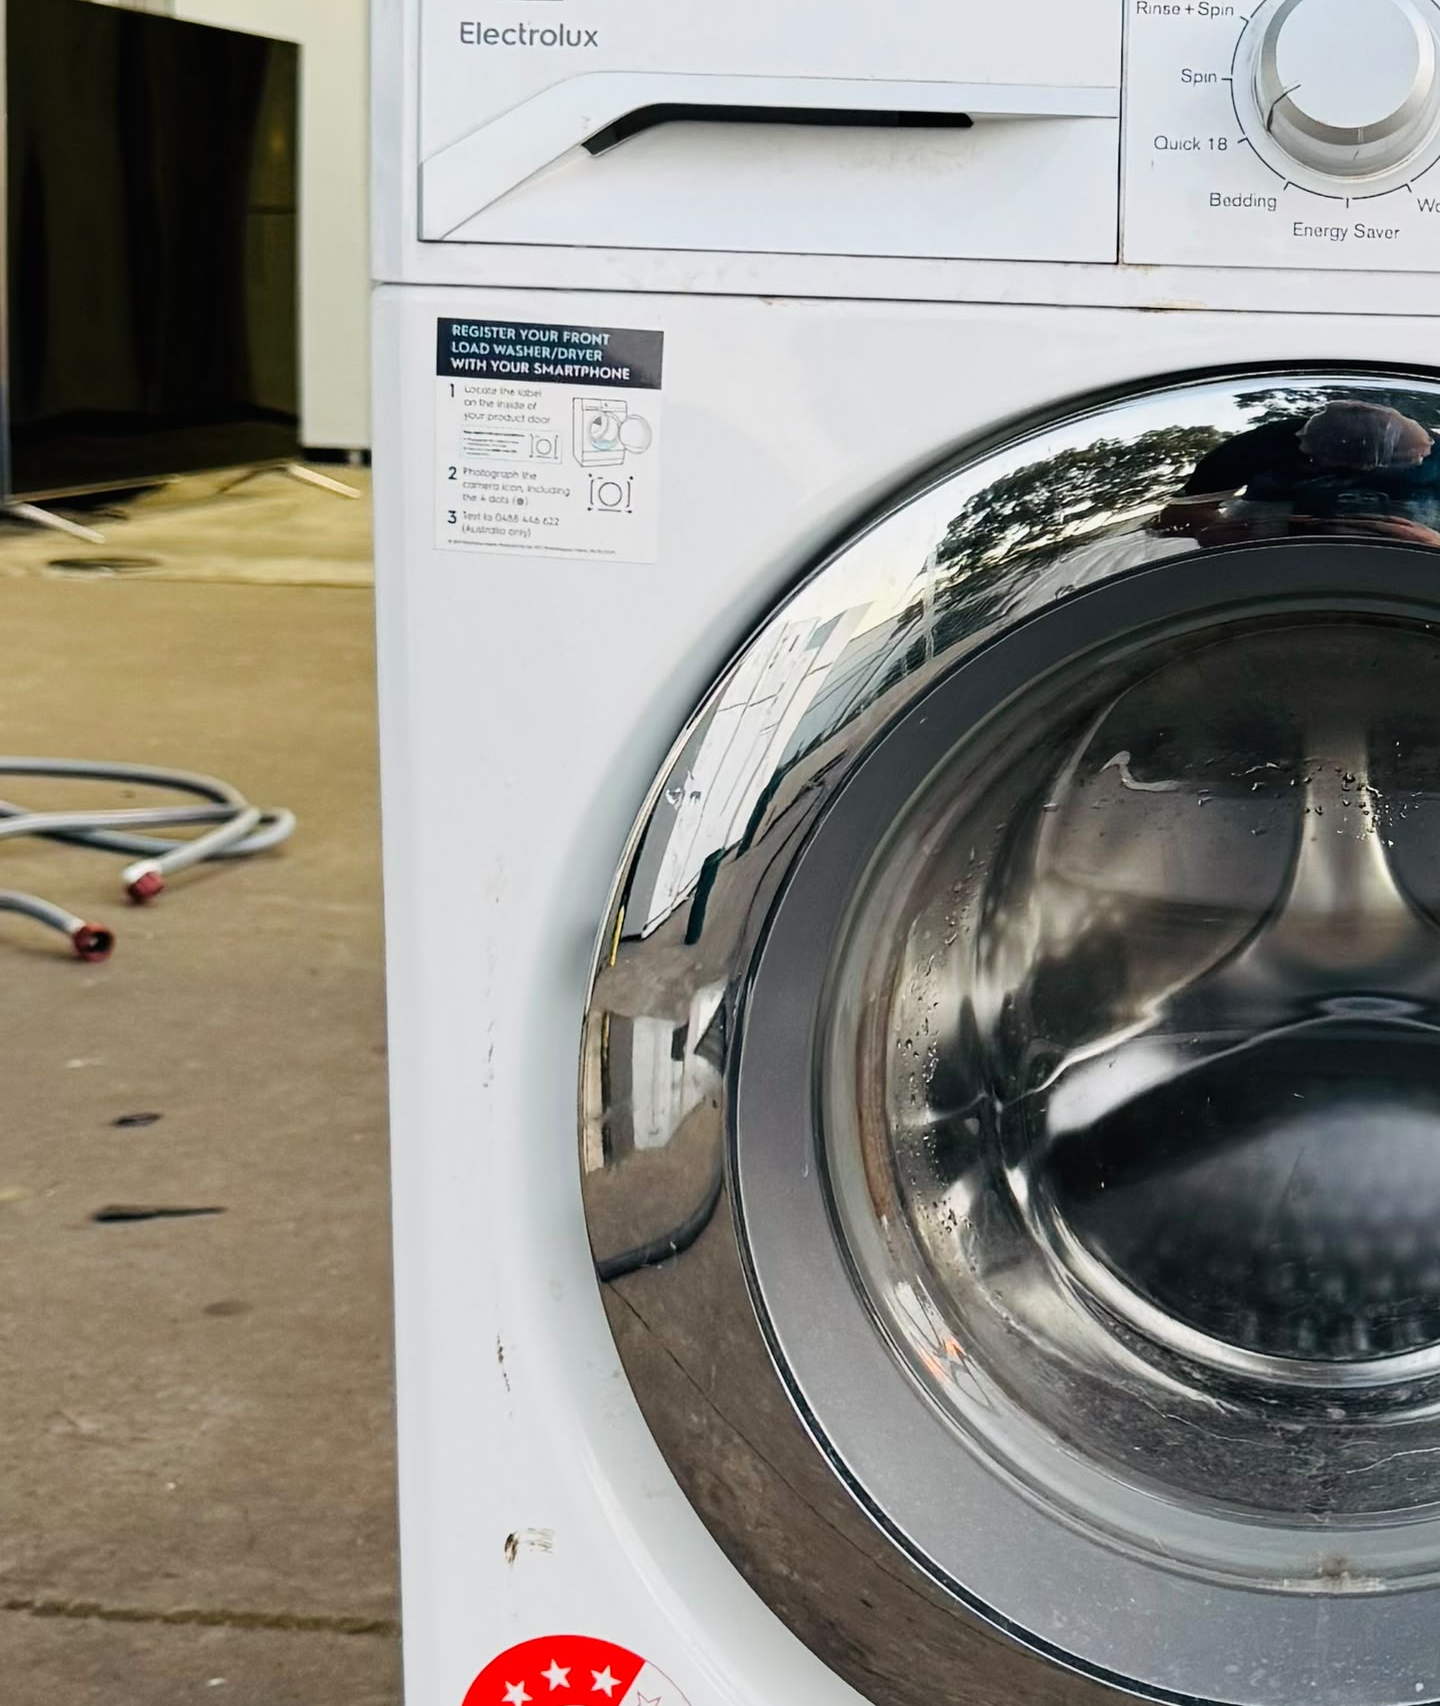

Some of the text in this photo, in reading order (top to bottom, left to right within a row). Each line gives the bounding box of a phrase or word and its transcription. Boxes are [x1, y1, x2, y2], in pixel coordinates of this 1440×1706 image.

[1136, 2, 1180, 16] Rinse
[460, 21, 599, 48] Electrolux
[1181, 69, 1217, 85] Spin
[1154, 136, 1228, 152] Quick 18
[1210, 193, 1277, 211] Bedding
[1293, 222, 1399, 241] Energy Saver
[452, 325, 610, 345] REGISTER YOUR FRONT
[452, 341, 602, 361] LOAD WASHER/DRYER
[450, 358, 631, 380] WITH YOUR SMARTPHONE
[450, 383, 454, 397] 1
[448, 467, 457, 480] 2
[448, 511, 456, 523] 3
